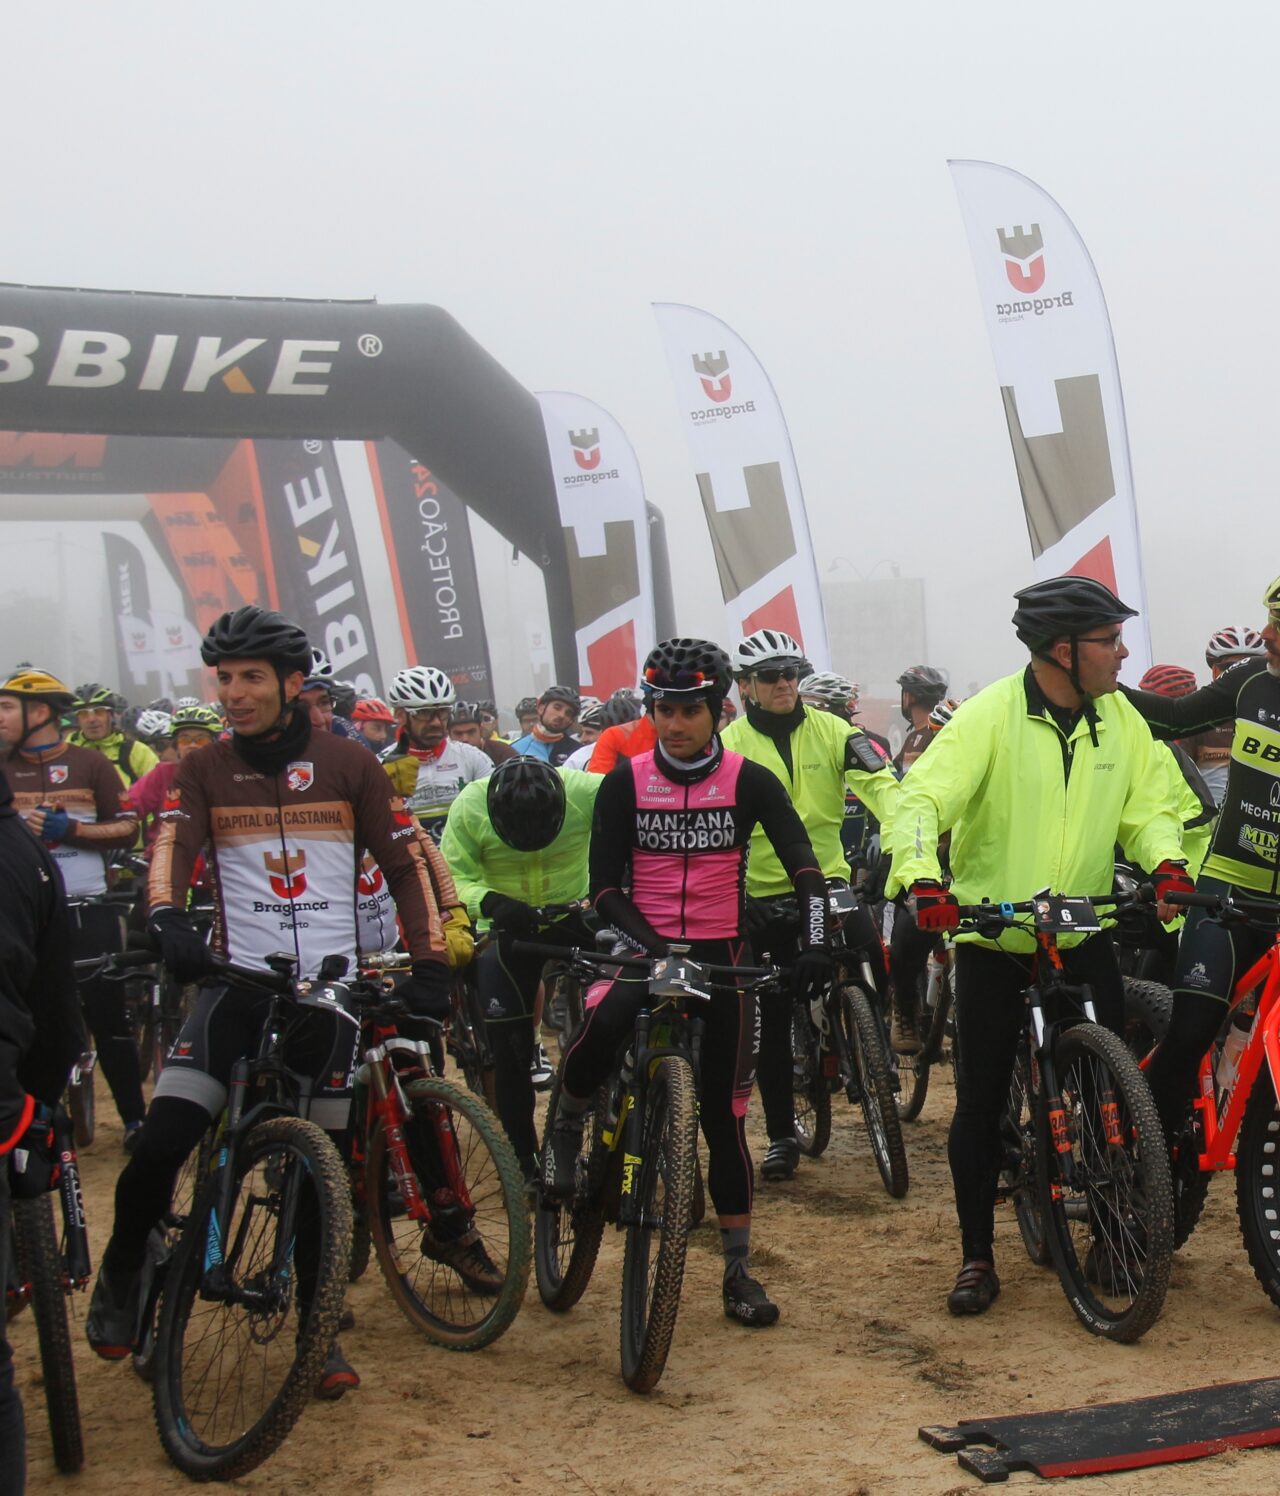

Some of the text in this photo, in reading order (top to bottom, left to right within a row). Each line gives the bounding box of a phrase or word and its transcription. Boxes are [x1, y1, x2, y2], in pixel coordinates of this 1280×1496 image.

[217, 814, 263, 831] CAPITAL
[283, 809, 343, 826] CASTANHA
[636, 811, 735, 831] MANZANA
[638, 828, 735, 850] POSTOBON
[253, 901, 329, 916] Bragança
[829, 898, 838, 907] 8
[809, 896, 825, 945] POSTOBON
[1061, 909, 1072, 921] 6
[677, 967, 686, 980] 1
[323, 988, 336, 1000] 3
[622, 1164, 634, 1195] FOX
